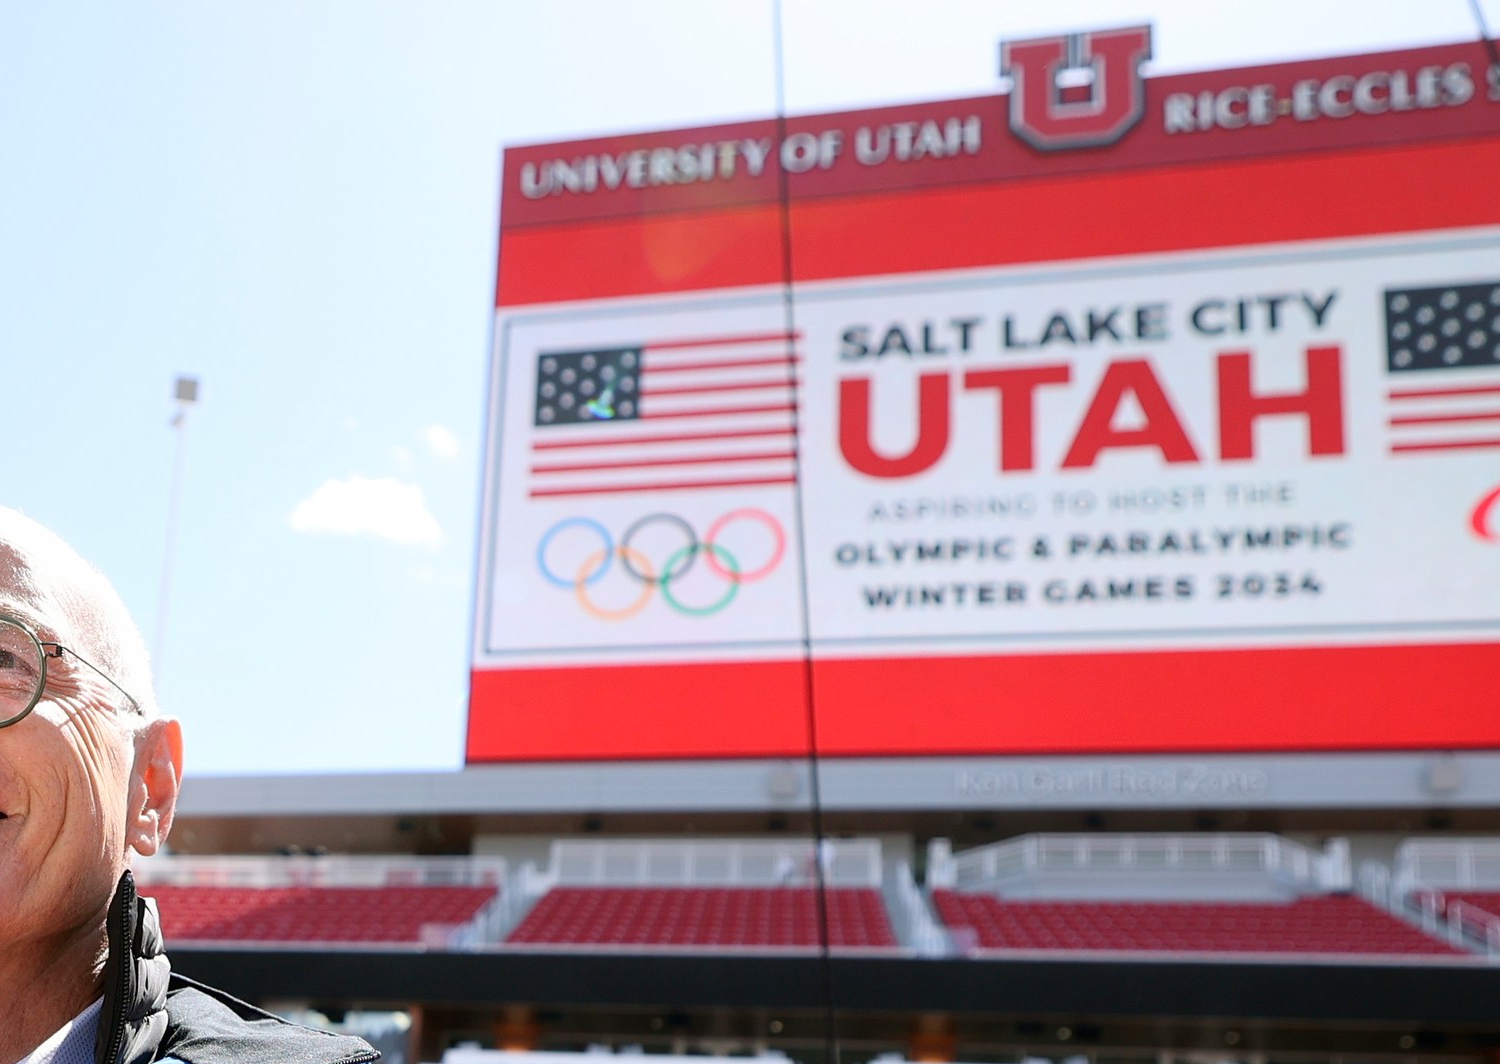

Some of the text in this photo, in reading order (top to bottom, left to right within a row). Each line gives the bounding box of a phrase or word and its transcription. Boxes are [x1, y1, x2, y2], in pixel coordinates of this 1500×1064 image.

[999, 23, 1155, 153] U
[1163, 62, 1475, 133] RICE-ECCLES
[519, 114, 982, 199] UNIVERSITY OF UTAH
[838, 288, 1341, 362] SALT LAKE CITY
[837, 340, 1347, 481] UTAH
[867, 479, 1297, 525] ASPIRING TO HOST THE
[833, 521, 1354, 567] OLYMPIC & PARALYMPIC
[861, 581, 1028, 610] WINTER
[1041, 575, 1197, 604] GAMES
